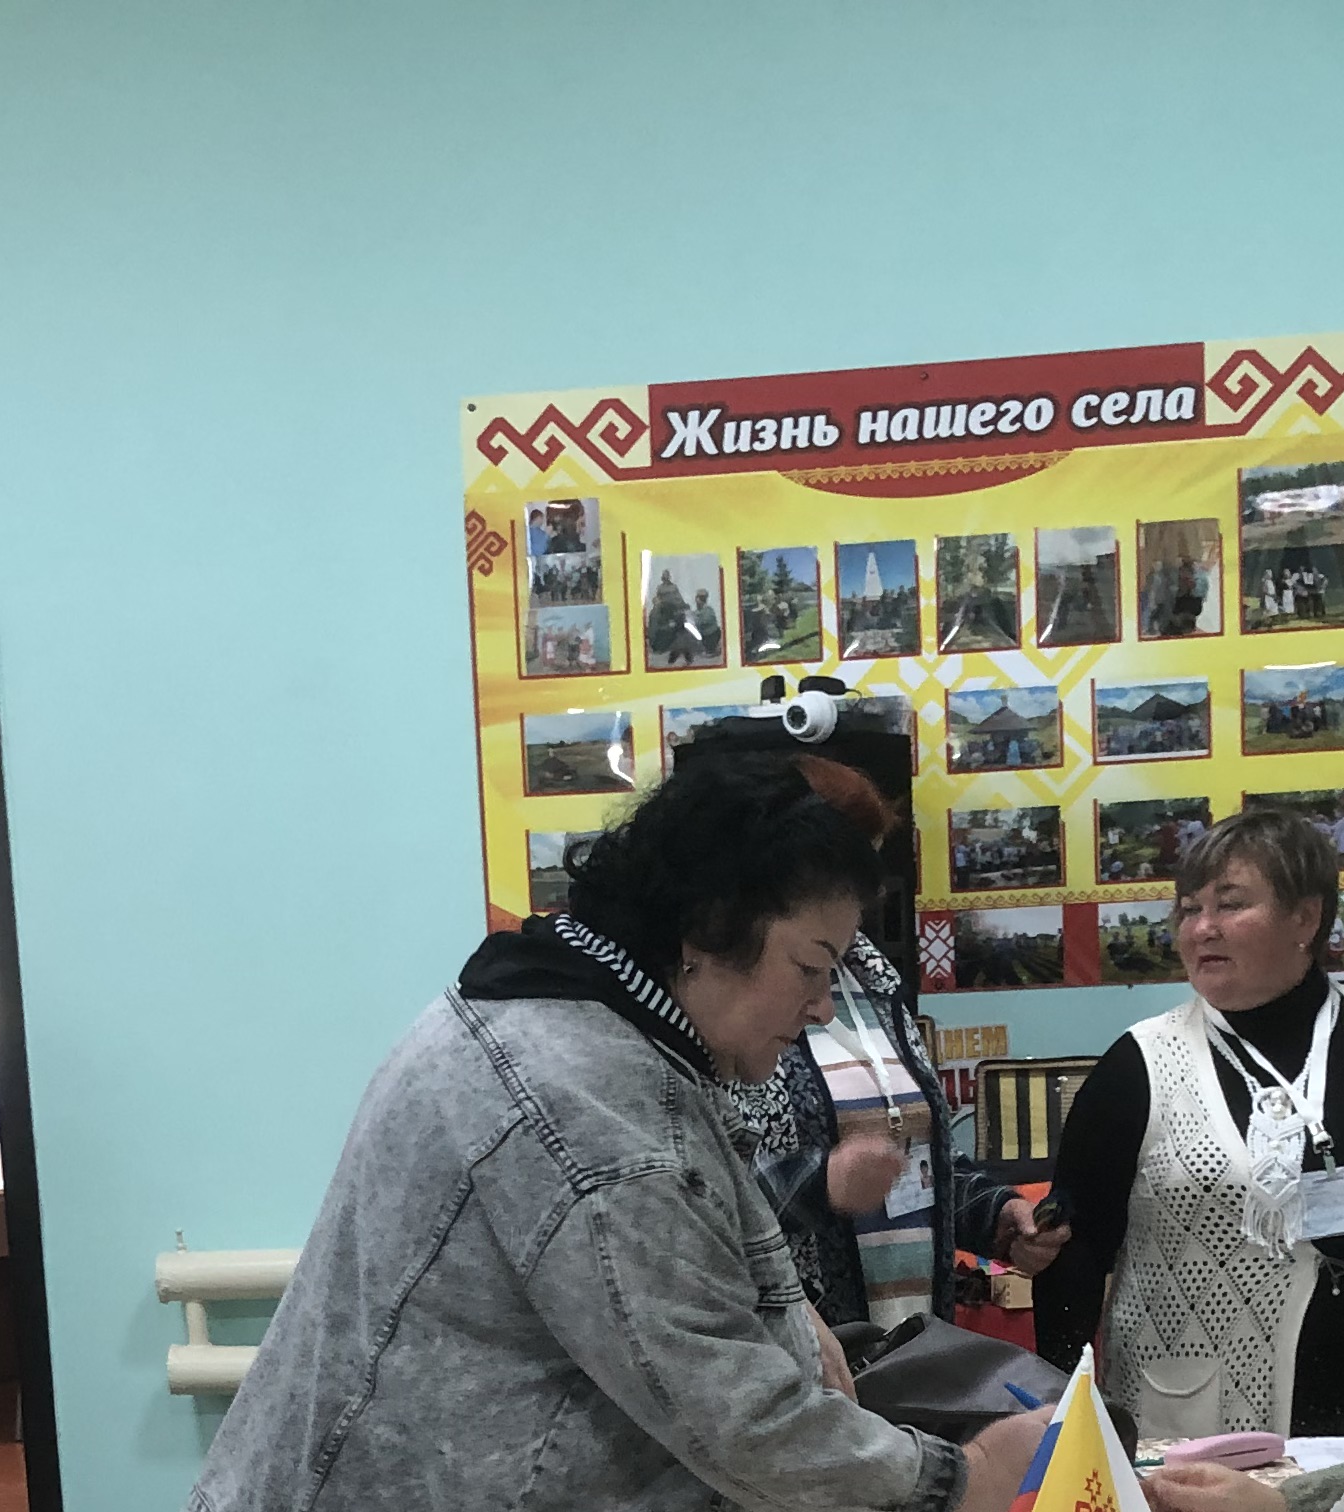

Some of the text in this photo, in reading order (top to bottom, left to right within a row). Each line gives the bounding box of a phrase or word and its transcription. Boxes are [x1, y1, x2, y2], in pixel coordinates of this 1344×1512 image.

[660, 385, 1196, 459] Жизнь нашего села
